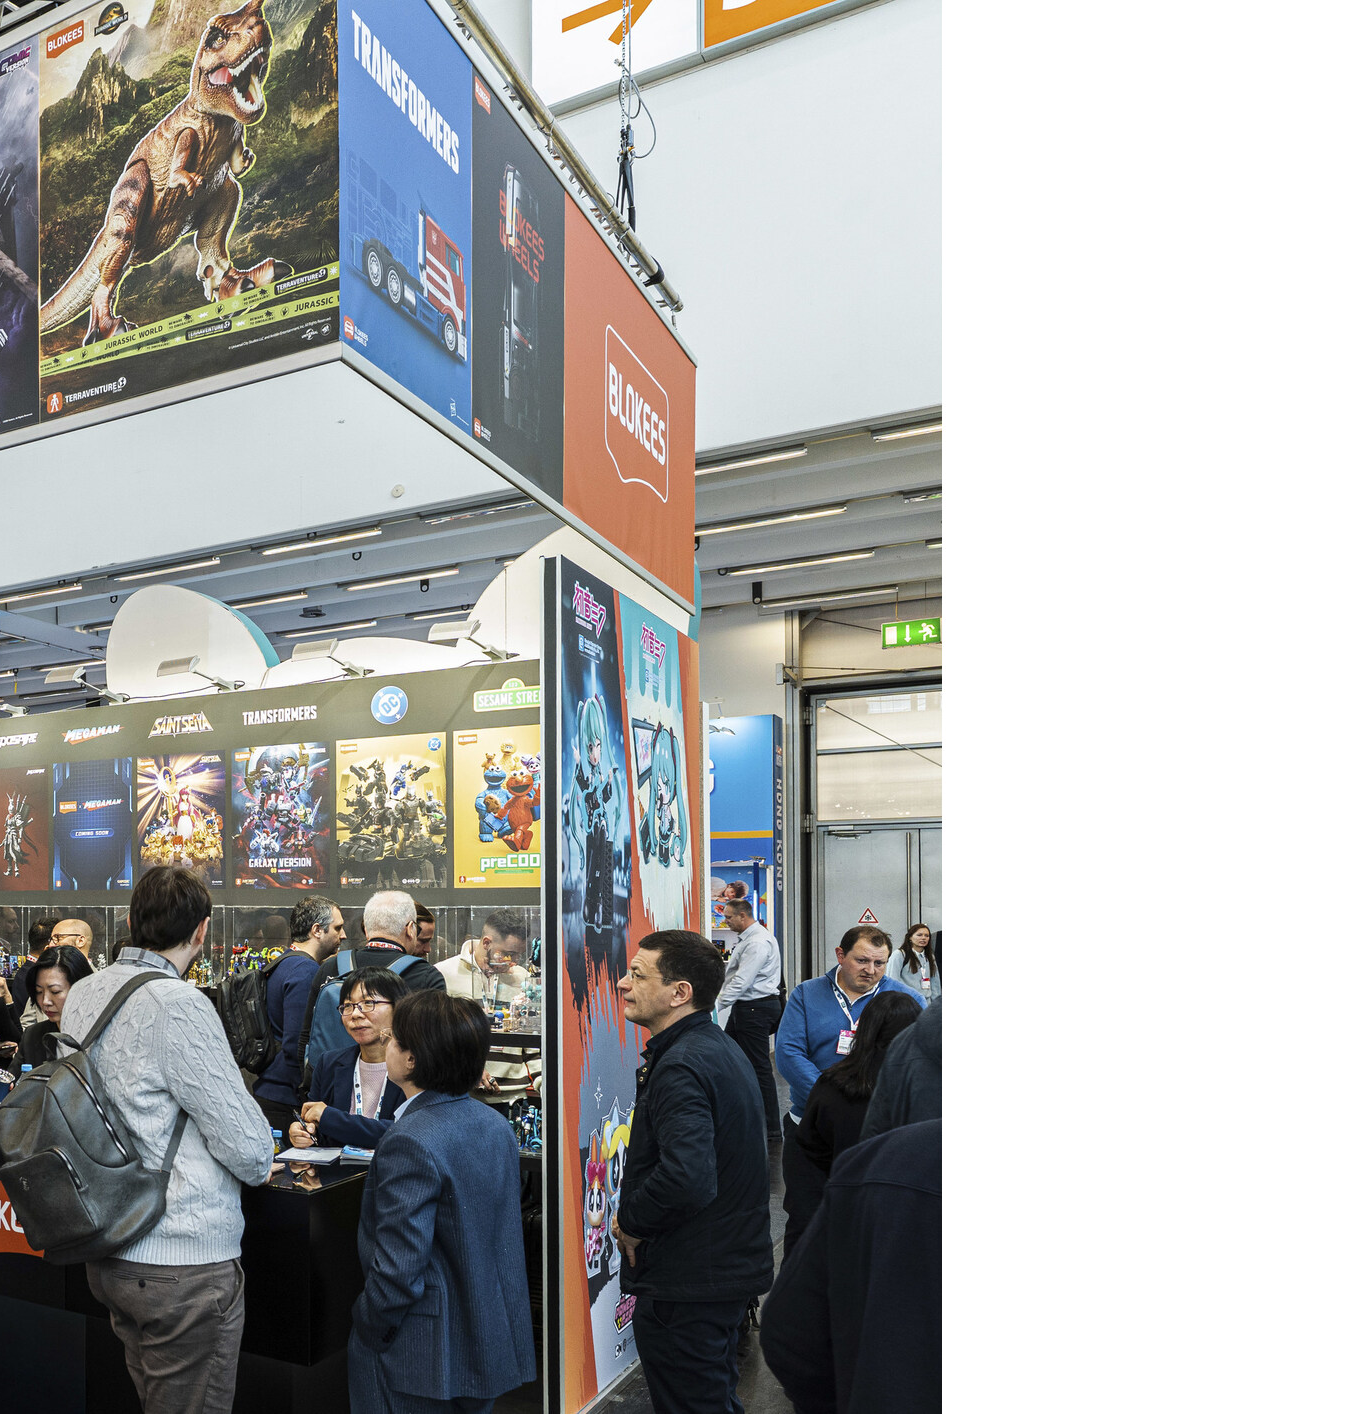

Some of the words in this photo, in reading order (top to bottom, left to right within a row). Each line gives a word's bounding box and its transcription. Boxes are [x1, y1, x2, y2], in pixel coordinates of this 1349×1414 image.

[47, 26, 83, 52] BLOKEES
[351, 10, 460, 175] TRANSFORMERS
[294, 296, 334, 313] JURASSIC
[104, 334, 136, 350] JURASSIC
[138, 325, 163, 339] WORLD
[65, 381, 119, 403] TERRAVENTURE
[608, 362, 666, 466] BLOKEES
[381, 695, 399, 714] DC
[478, 693, 513, 708] SESAME
[515, 690, 540, 704] STRE
[242, 705, 318, 726] TRANSFORMERS
[63, 725, 121, 742] MEGAMAN
[149, 714, 182, 738] SAINT
[84, 799, 122, 809] MEGAMAN
[248, 858, 278, 868] GALAXY
[278, 857, 312, 868] VERSION
[481, 853, 540, 872] preCOO
